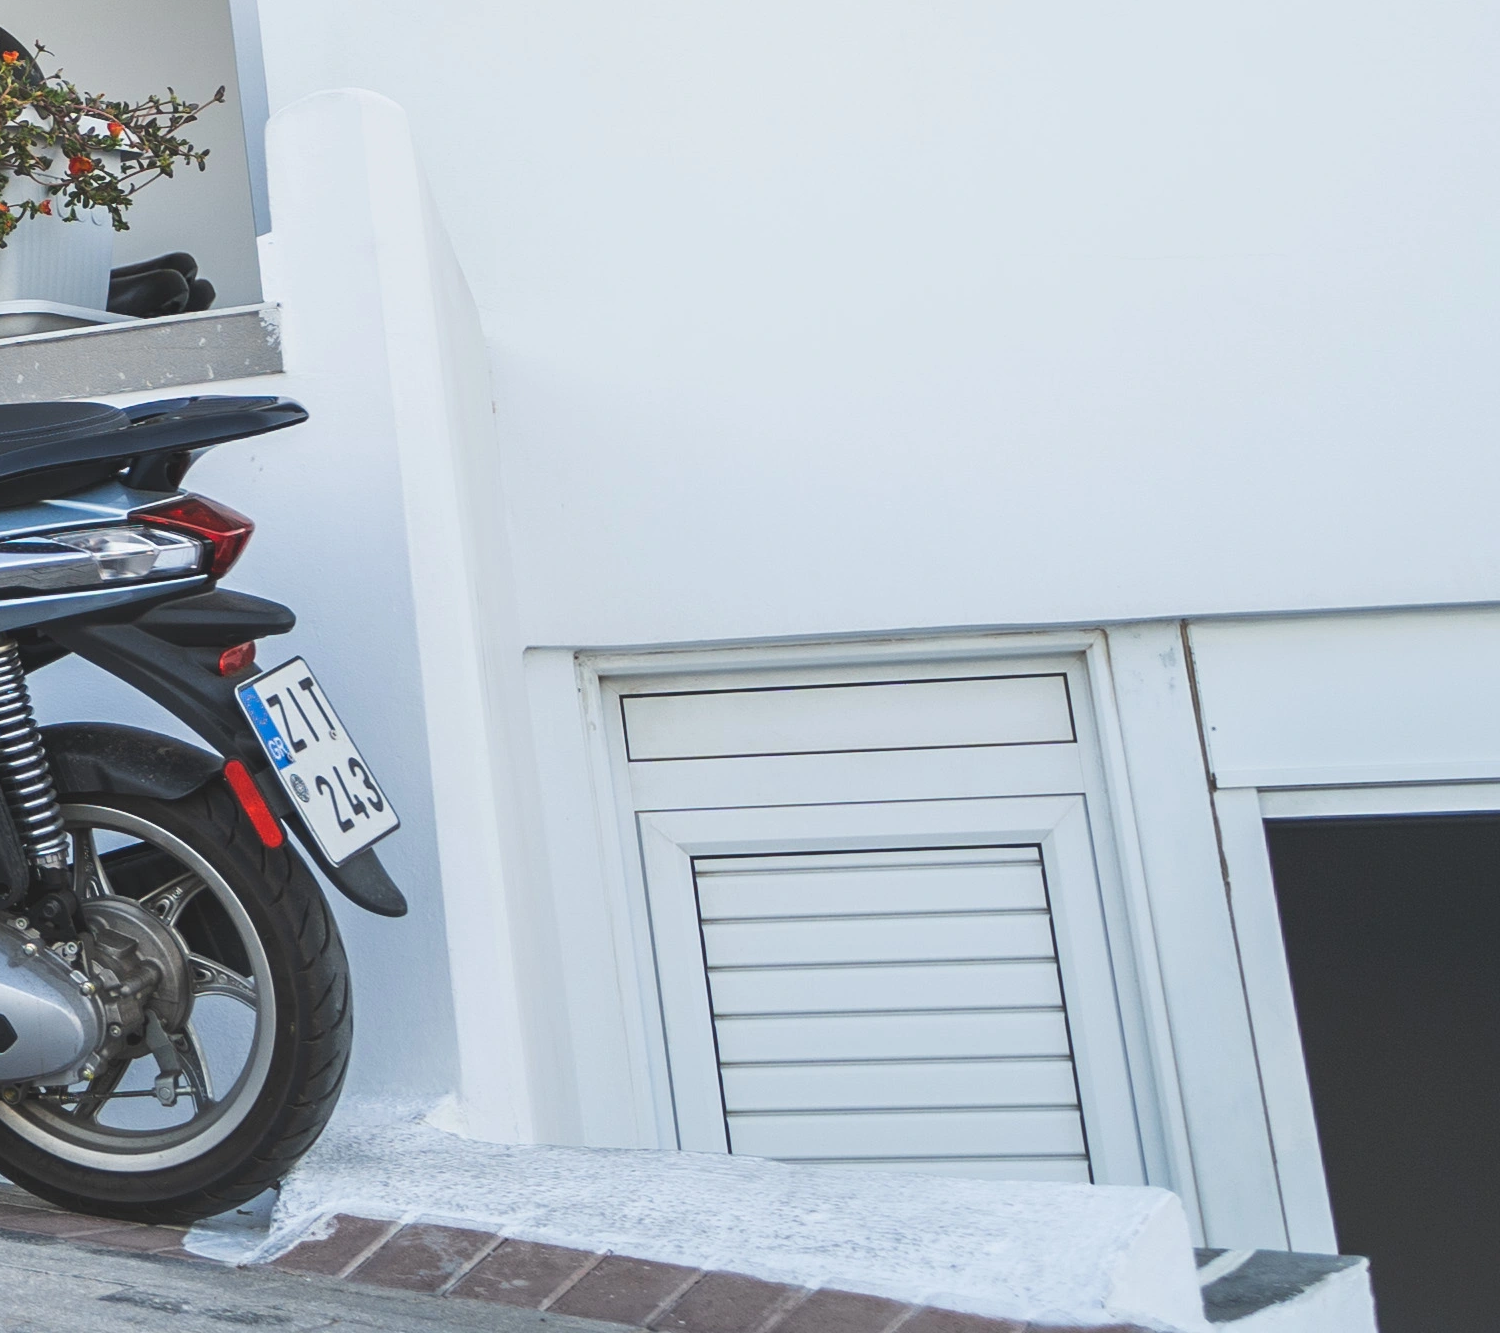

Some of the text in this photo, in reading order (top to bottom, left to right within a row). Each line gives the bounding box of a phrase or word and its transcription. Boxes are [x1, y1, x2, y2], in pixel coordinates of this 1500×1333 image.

[266, 677, 339, 753] ZIT
[268, 737, 291, 761] GR
[315, 757, 384, 833] 243
